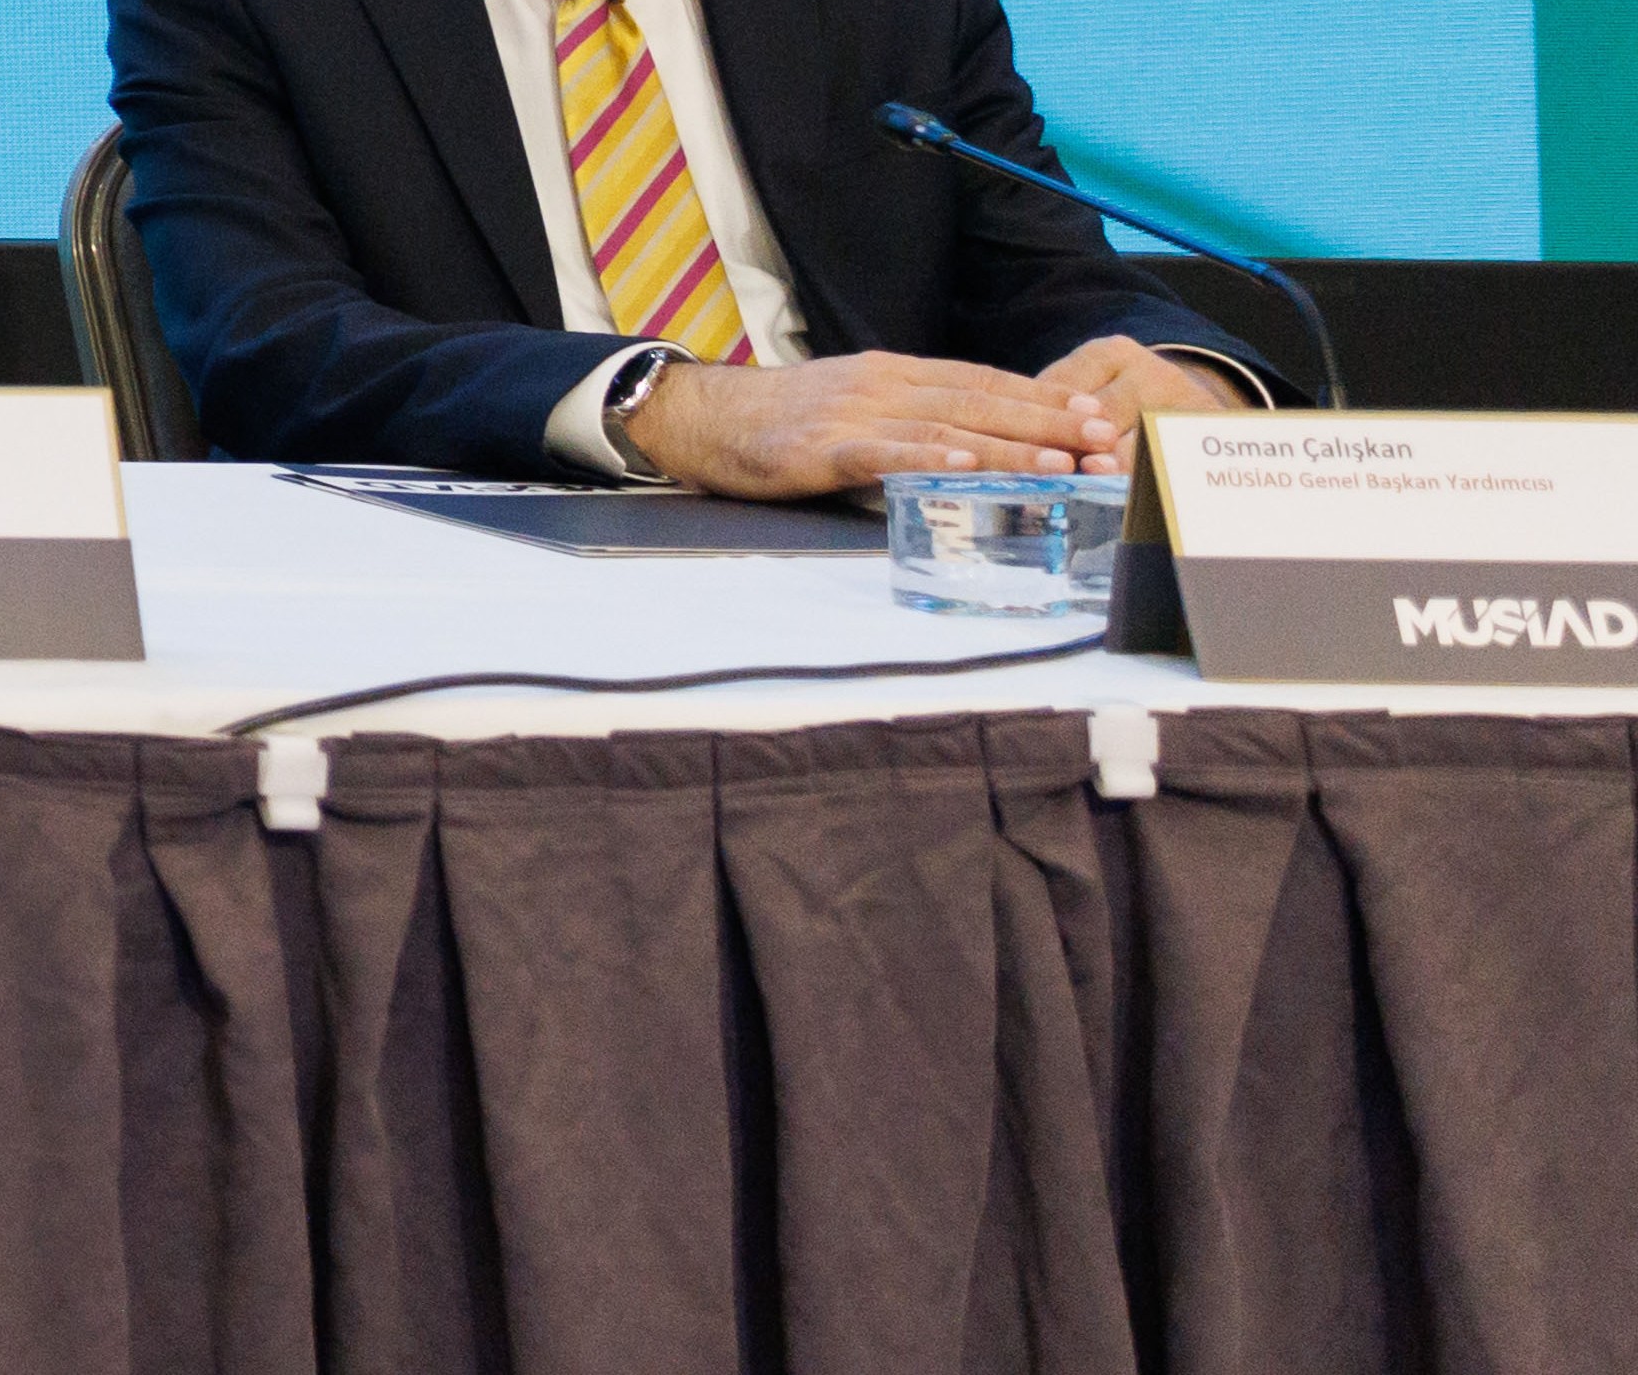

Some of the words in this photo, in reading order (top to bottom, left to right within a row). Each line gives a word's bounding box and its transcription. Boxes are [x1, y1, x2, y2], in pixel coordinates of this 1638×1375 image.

[1202, 436, 1294, 458] Osman
[1302, 437, 1413, 462] Çalışkan
[1299, 472, 1359, 489] Genel
[1366, 473, 1439, 494] Başkan
